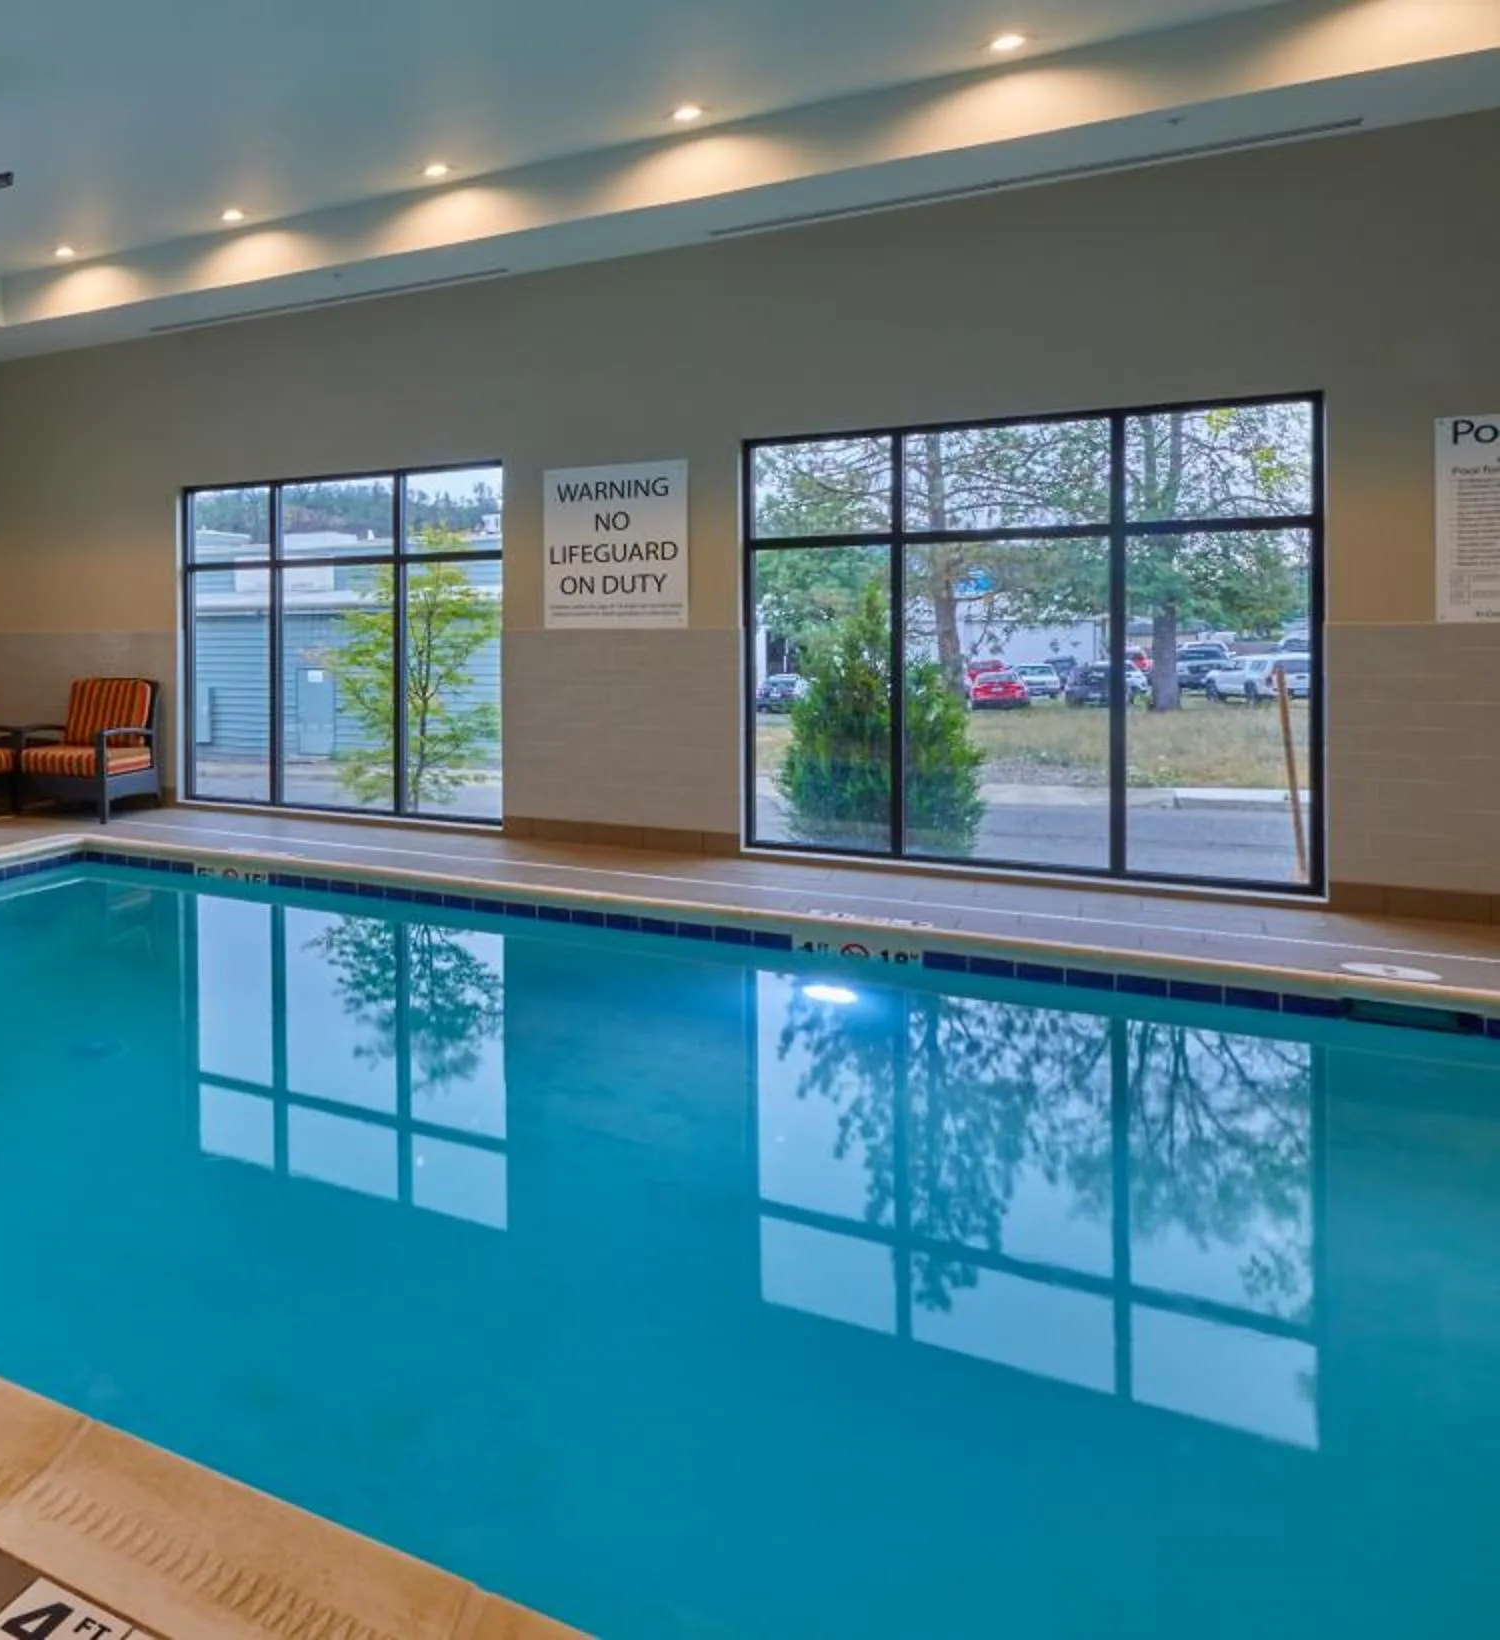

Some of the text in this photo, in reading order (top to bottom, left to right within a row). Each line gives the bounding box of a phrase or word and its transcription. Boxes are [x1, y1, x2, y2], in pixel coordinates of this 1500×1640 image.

[557, 477, 669, 503] WARNING
[595, 511, 630, 532] NO
[549, 541, 678, 565] LIFEGUARD
[560, 573, 668, 595] ON DUTY
[0, 1602, 112, 1640] 4 FT
